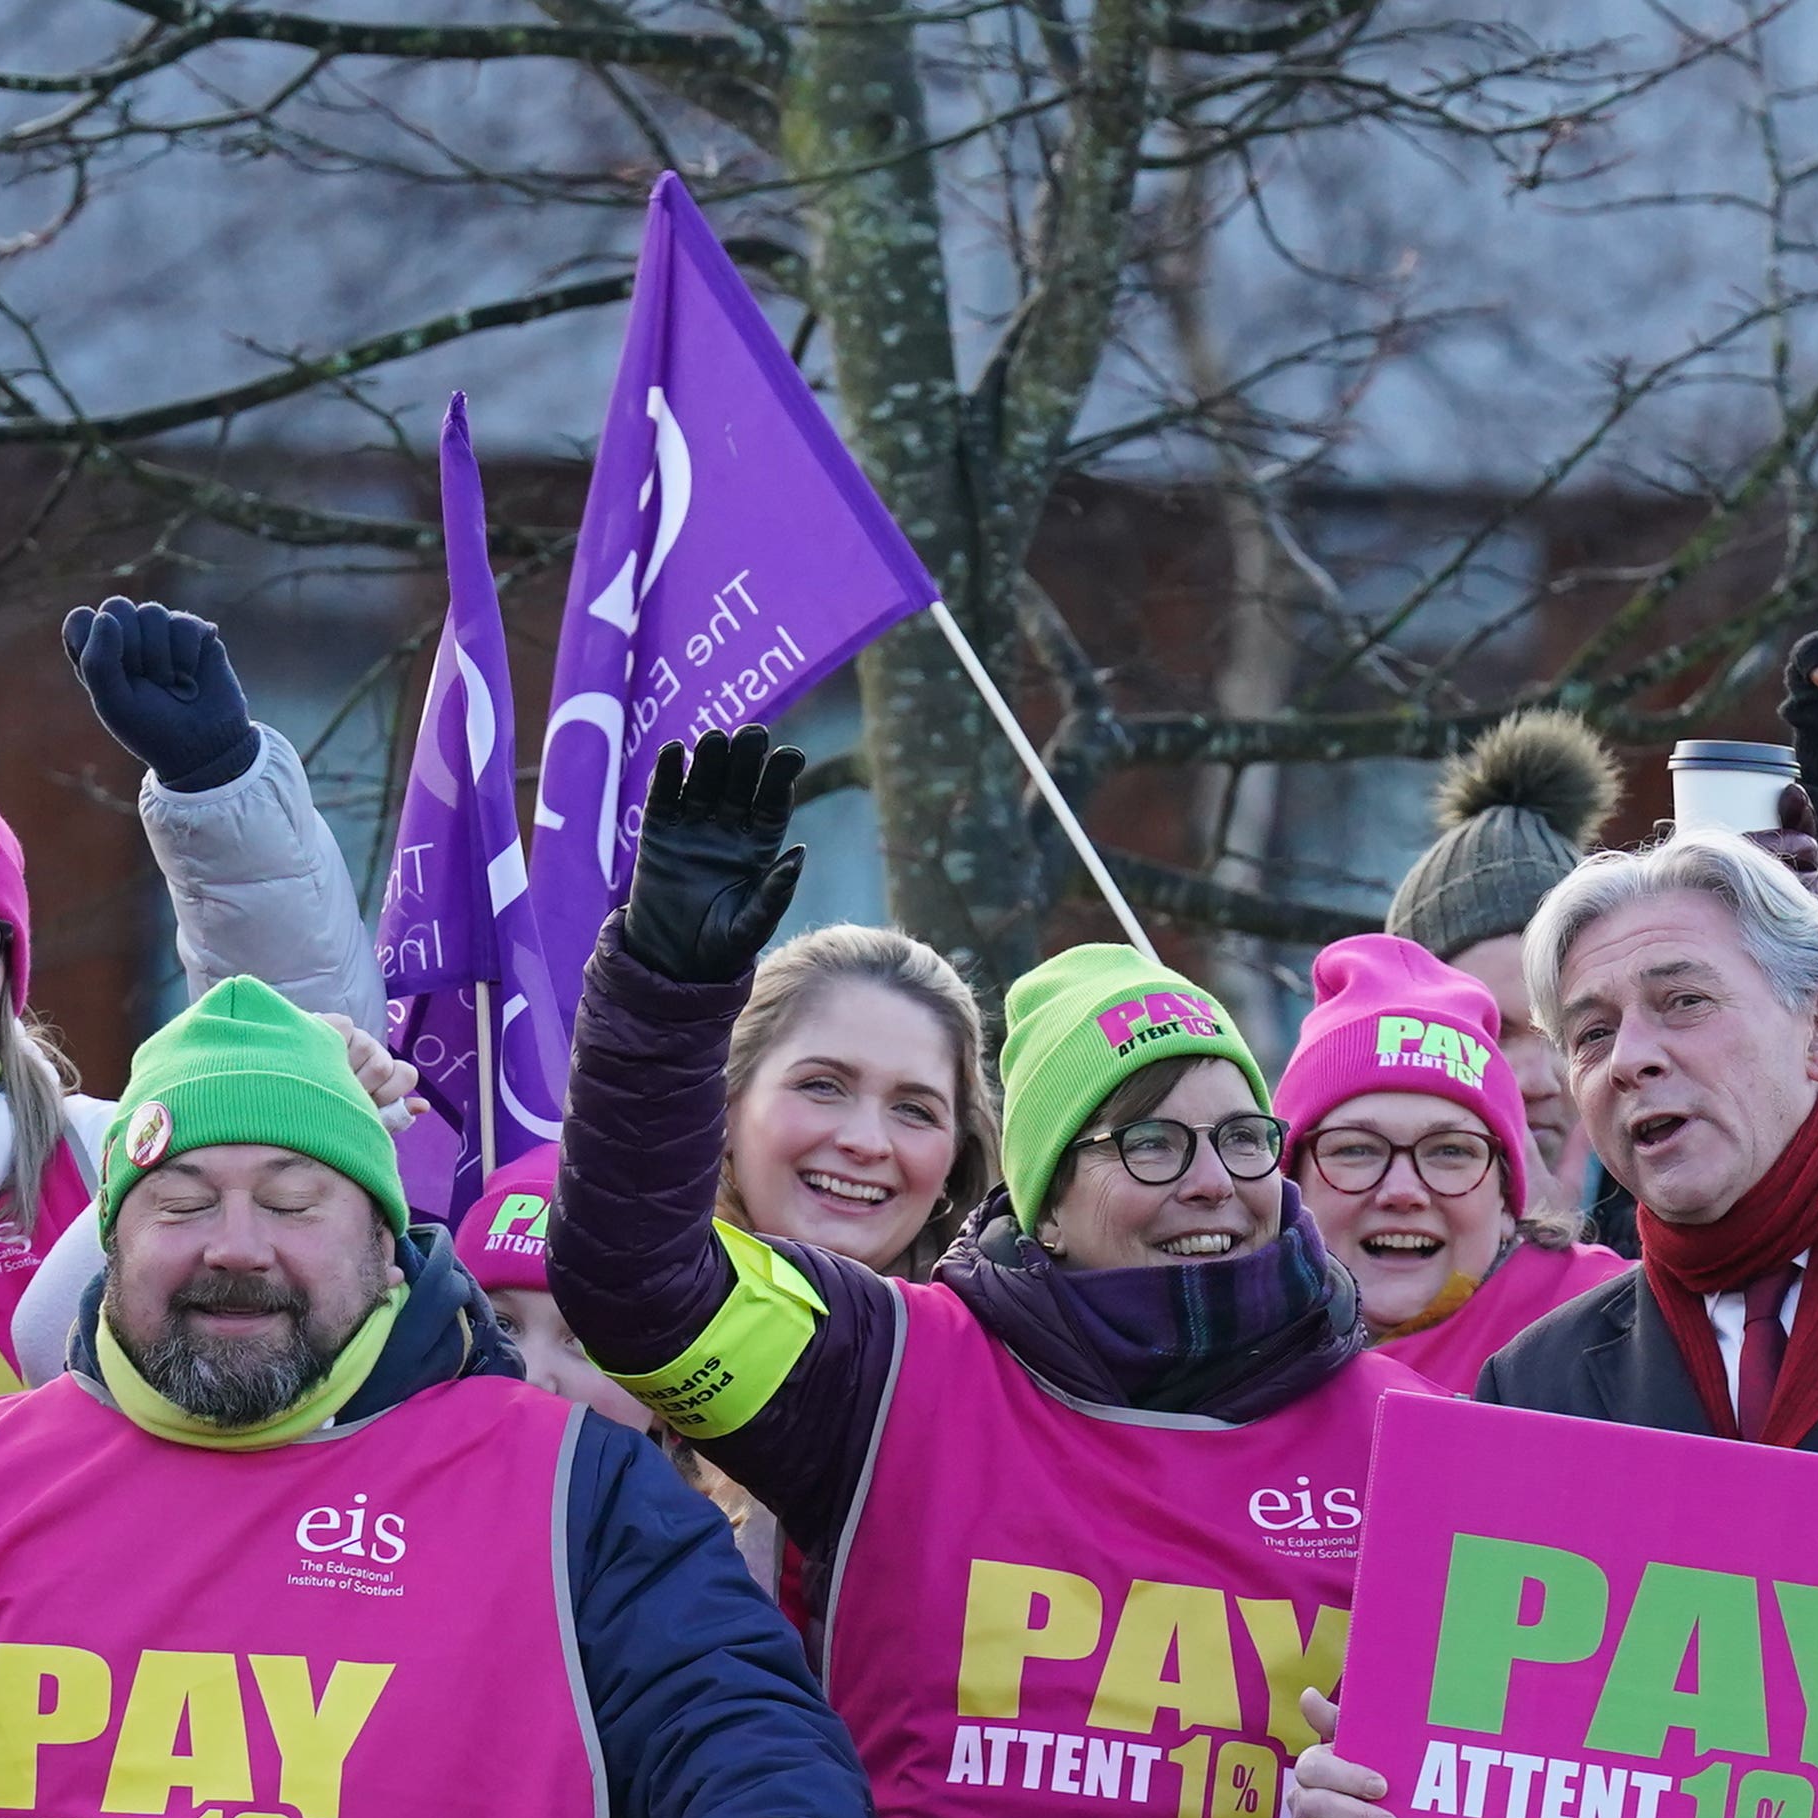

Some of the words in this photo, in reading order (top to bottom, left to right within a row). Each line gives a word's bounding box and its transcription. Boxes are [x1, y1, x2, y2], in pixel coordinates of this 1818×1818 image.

[1096, 991, 1218, 1049] PAY
[1375, 1015, 1493, 1079] PAY
[295, 1493, 407, 1565] eis
[1248, 1475, 1363, 1530] eis
[1262, 1535, 1285, 1547] The
[1287, 1534, 1357, 1548] Educational
[287, 1573, 336, 1588] Institute
[338, 1576, 353, 1590] of
[353, 1579, 404, 1597] Scotland
[300, 1559, 324, 1572] The
[326, 1561, 394, 1583] Educational
[957, 1558, 1355, 1757] PAY
